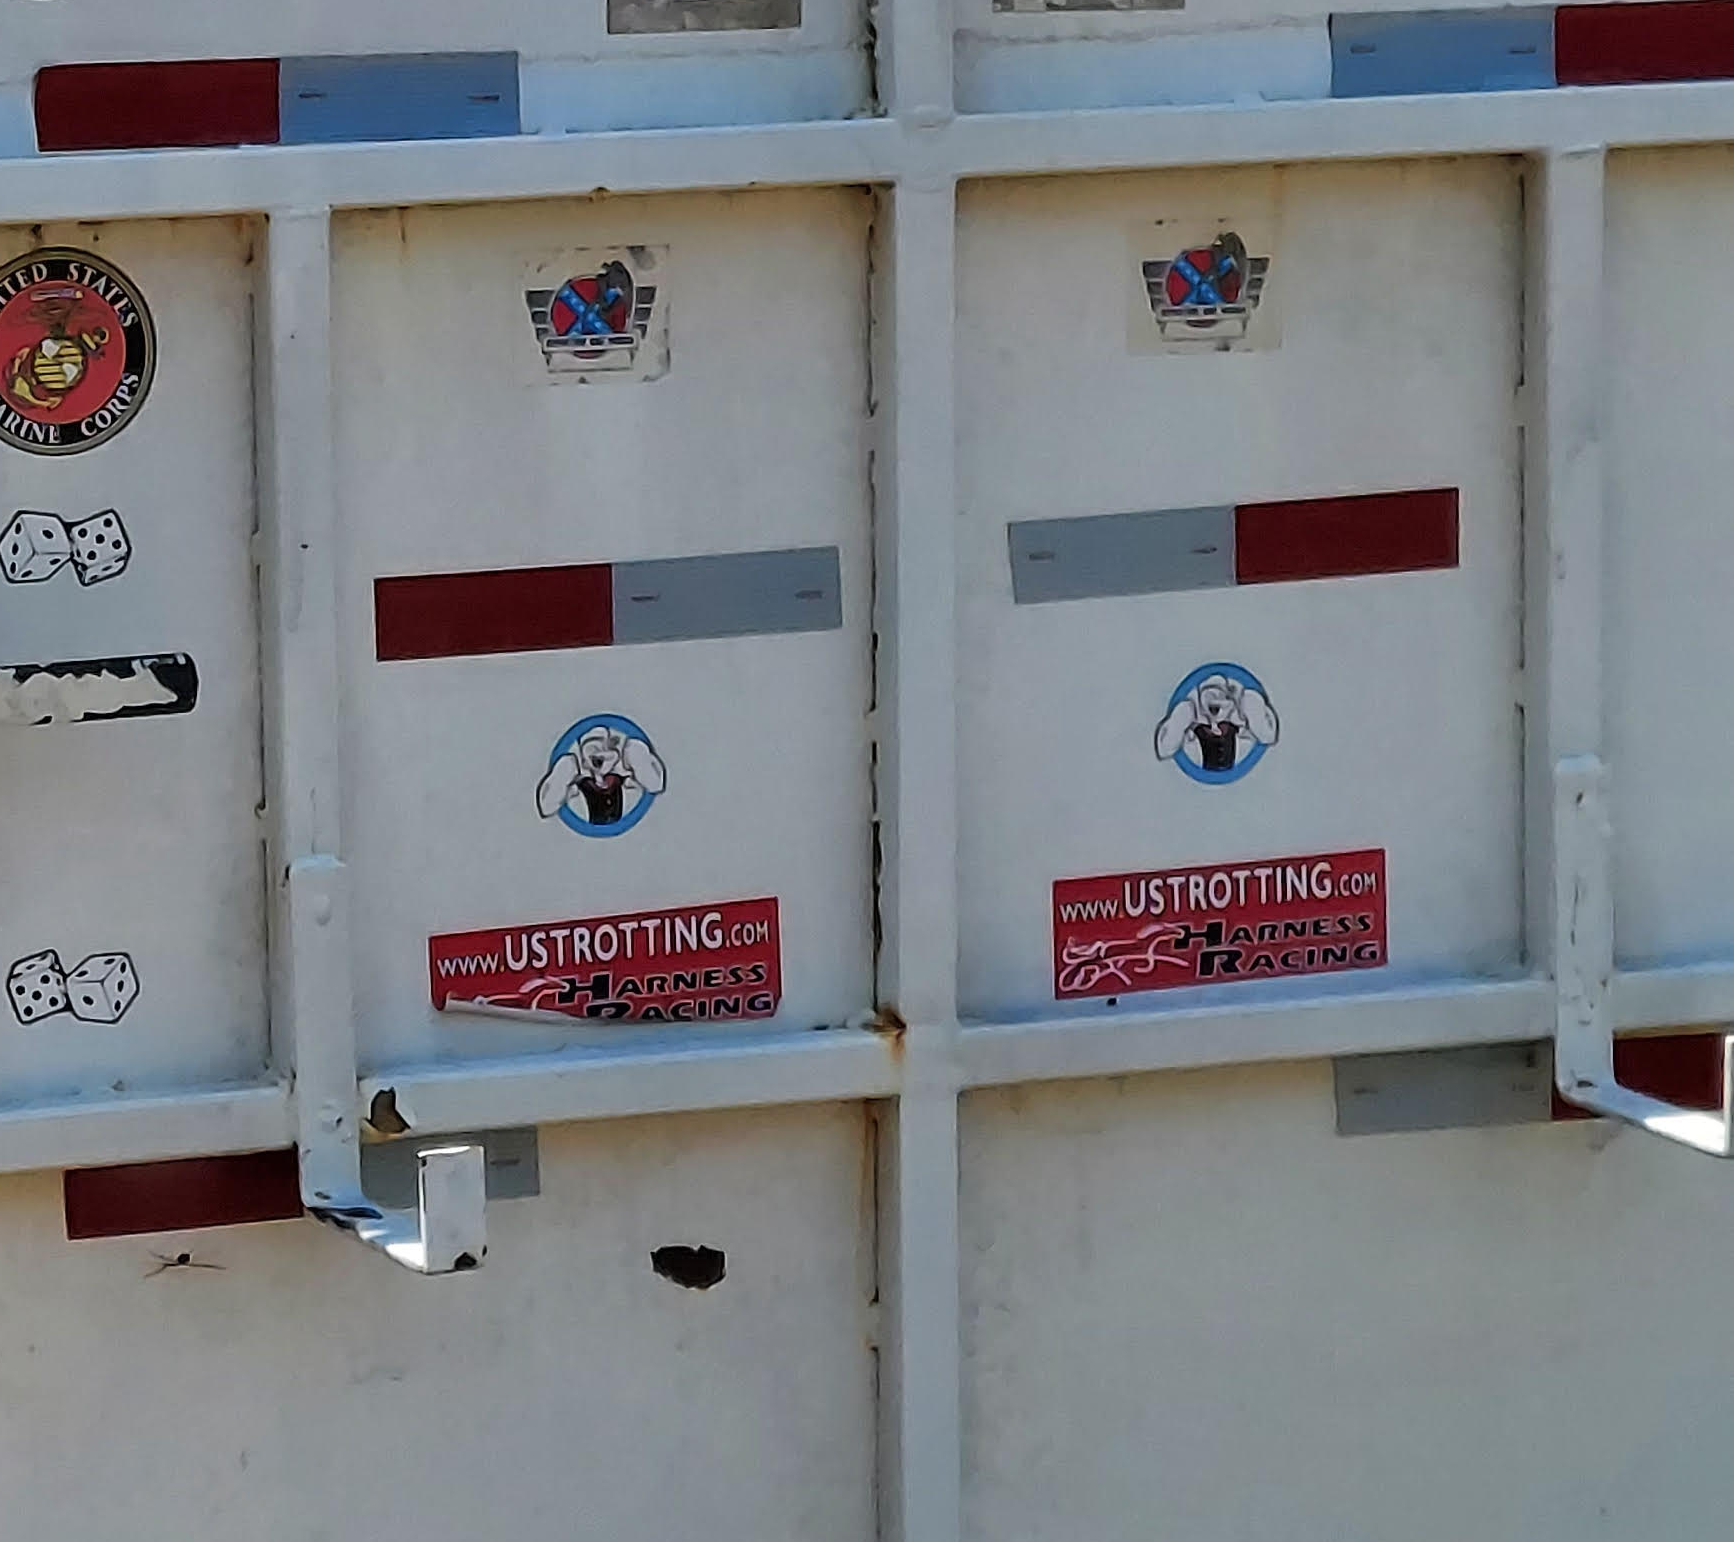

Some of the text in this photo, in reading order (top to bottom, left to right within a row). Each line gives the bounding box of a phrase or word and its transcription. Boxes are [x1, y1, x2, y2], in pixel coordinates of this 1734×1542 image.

[66, 262, 139, 329] STATES
[80, 371, 139, 437] CORPS
[1173, 914, 1372, 950] HARNESS
[1197, 943, 1379, 977] RACING
[557, 964, 767, 1004] HARNESS
[585, 993, 773, 1021] RACING
